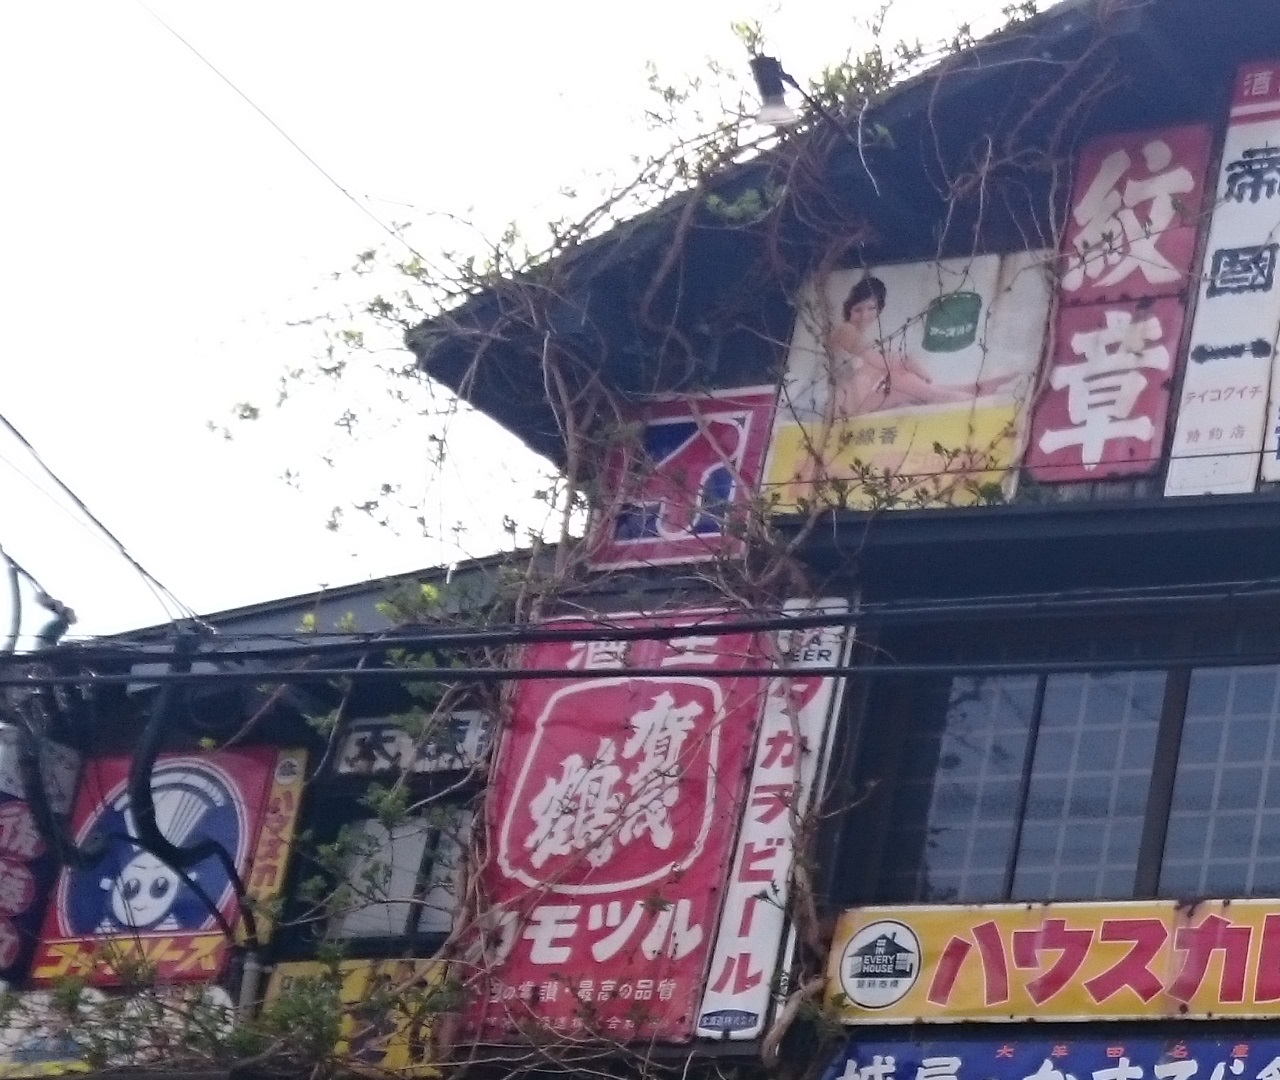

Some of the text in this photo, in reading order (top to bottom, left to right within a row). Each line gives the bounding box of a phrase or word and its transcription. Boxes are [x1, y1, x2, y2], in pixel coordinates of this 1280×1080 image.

[1039, 140, 1194, 472] 紋章
[875, 946, 886, 955] IN
[863, 954, 896, 965] EVERY
[862, 963, 894, 974] HOUSE
